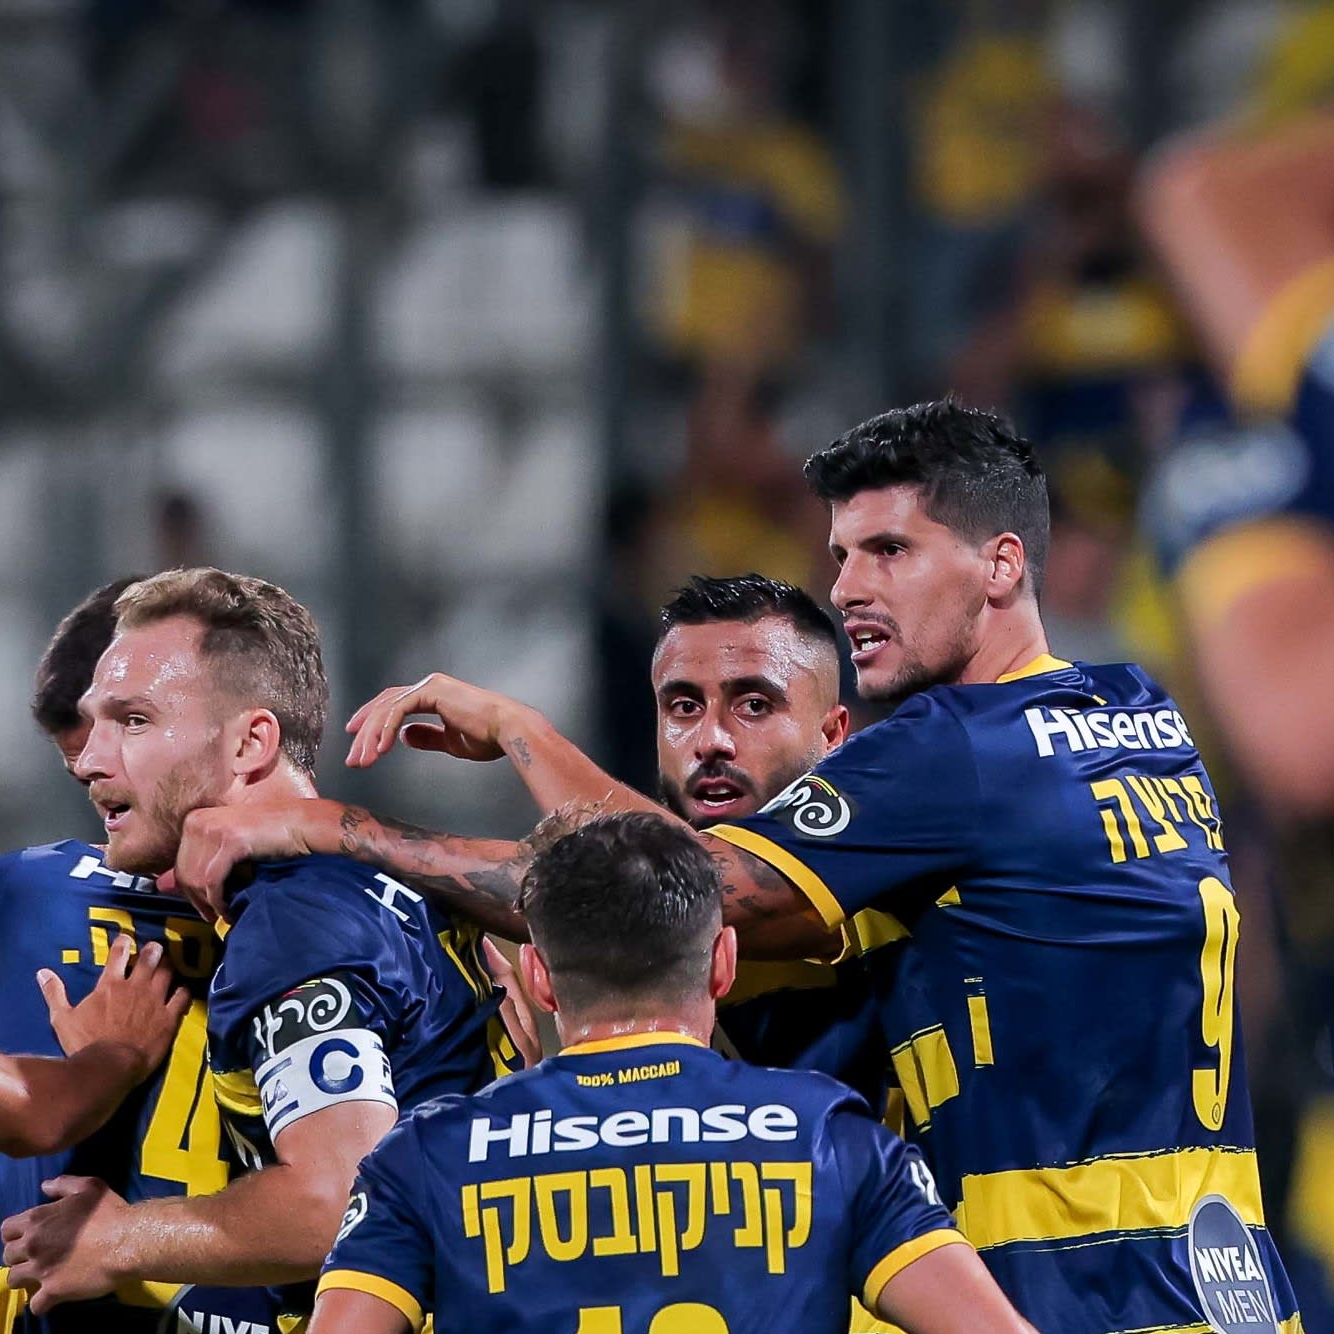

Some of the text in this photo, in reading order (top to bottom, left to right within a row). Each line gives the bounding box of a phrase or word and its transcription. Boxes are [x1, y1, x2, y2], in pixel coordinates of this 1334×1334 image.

[1024, 707, 1194, 758] Hisense
[1192, 877, 1240, 1132] 9
[309, 1038, 364, 1095] C
[576, 1060, 680, 1087] 100% MACCABI
[468, 1104, 798, 1163] Hisense
[462, 1162, 812, 1293] קניקובסקי
[1195, 1244, 1263, 1283] NIVEA
[1216, 1289, 1272, 1325] MEN
